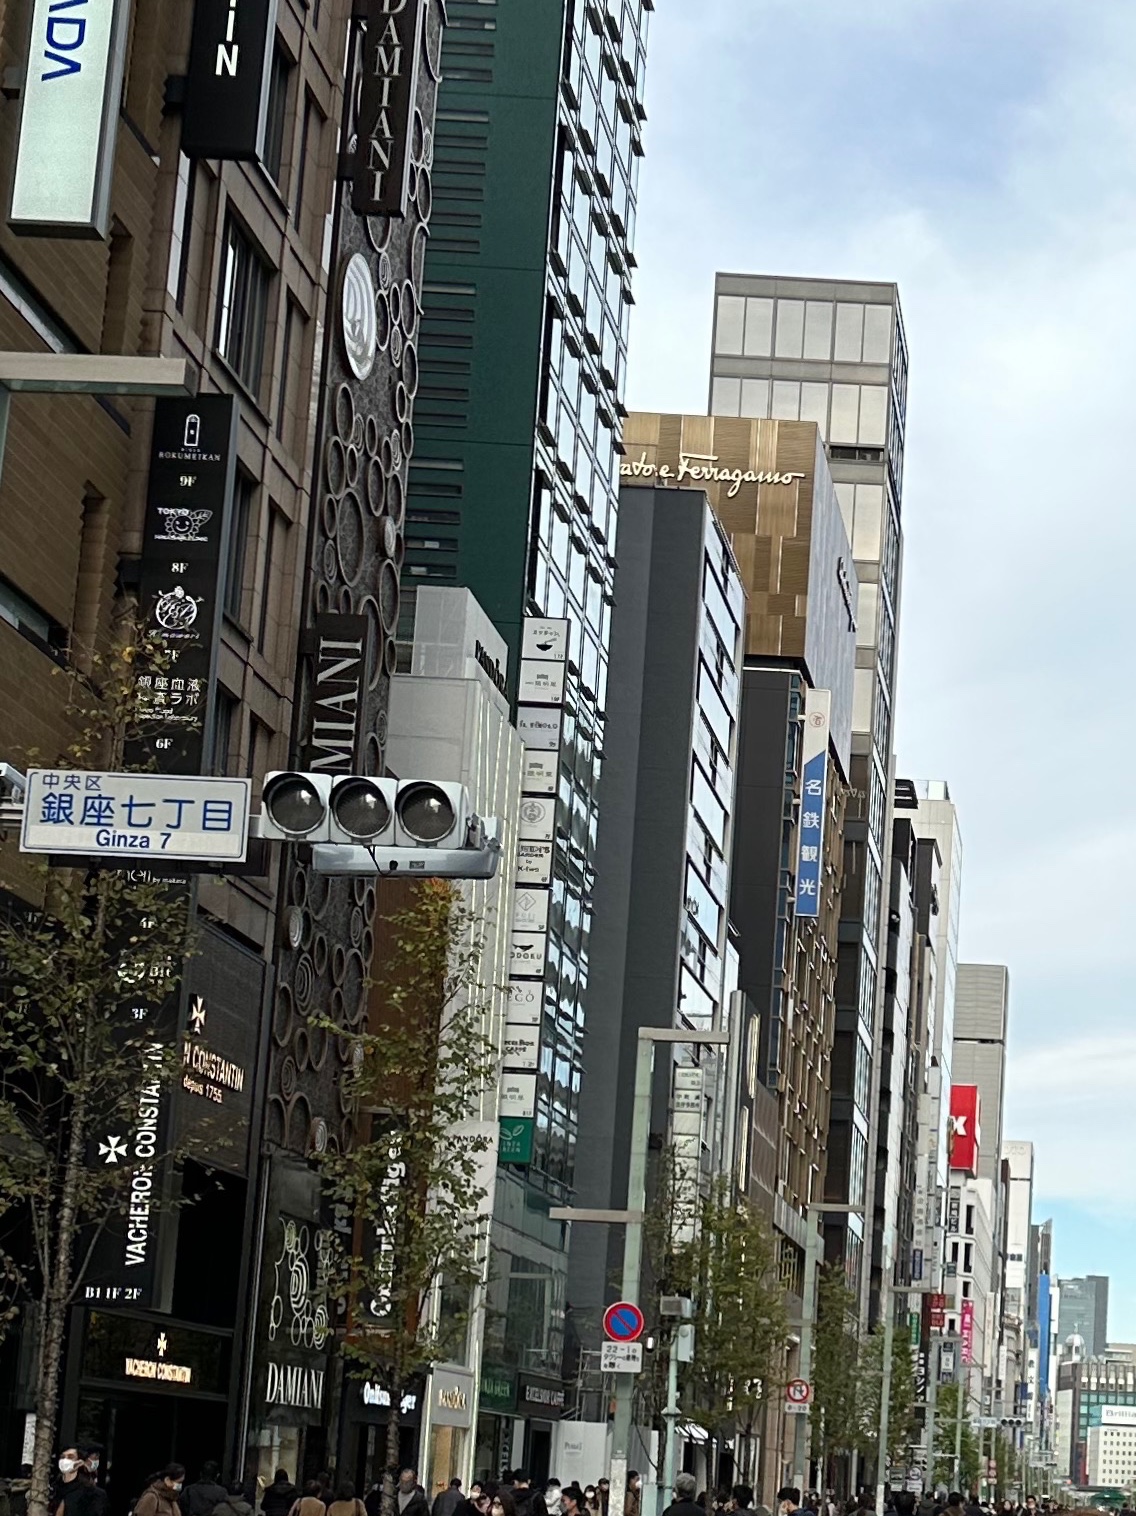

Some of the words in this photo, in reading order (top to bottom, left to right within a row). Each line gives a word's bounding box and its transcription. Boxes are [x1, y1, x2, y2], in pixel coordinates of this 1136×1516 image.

[677, 452, 806, 498] Ferragamo
[171, 562, 189, 574] 8F
[155, 738, 174, 750] 6F
[42, 773, 103, 791] 中央区
[39, 791, 233, 831] 銀座七丁目
[95, 829, 151, 849] Ginza
[160, 833, 172, 849] 7
[799, 779, 822, 896] 名鉄観光
[124, 1287, 143, 1300] 2F
[265, 1361, 325, 1410] DAMIANI
